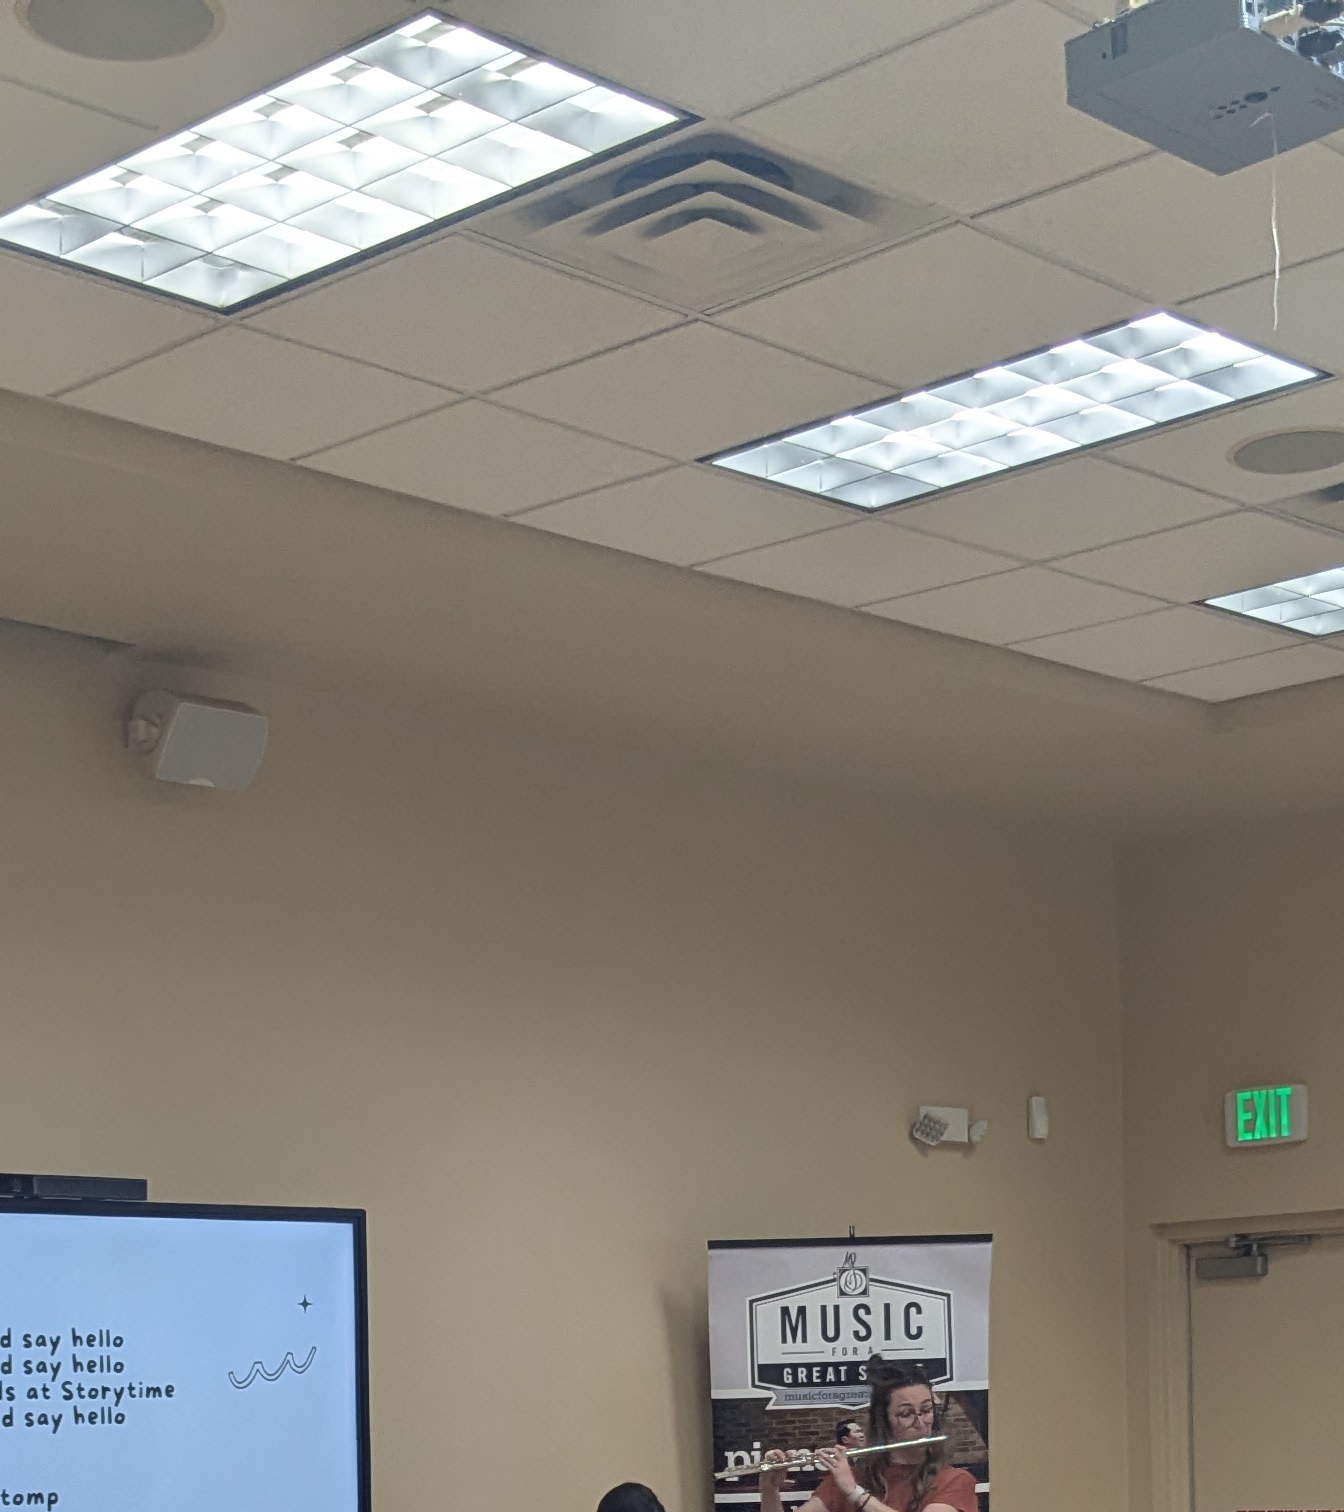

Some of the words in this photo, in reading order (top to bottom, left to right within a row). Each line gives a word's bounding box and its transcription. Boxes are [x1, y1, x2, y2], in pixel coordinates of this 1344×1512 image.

[1236, 1087, 1292, 1141] EXIT
[780, 1301, 923, 1345] MUSIC
[22, 1332, 61, 1356] say
[71, 1327, 124, 1349] hello
[831, 1346, 858, 1357] FOR
[867, 1346, 873, 1355] A
[23, 1359, 62, 1382] say
[72, 1354, 125, 1375] hello
[783, 1365, 848, 1384] GREAT
[26, 1382, 51, 1400] at
[61, 1380, 176, 1407] Storytime
[24, 1410, 63, 1434] say
[73, 1405, 126, 1426] hello
